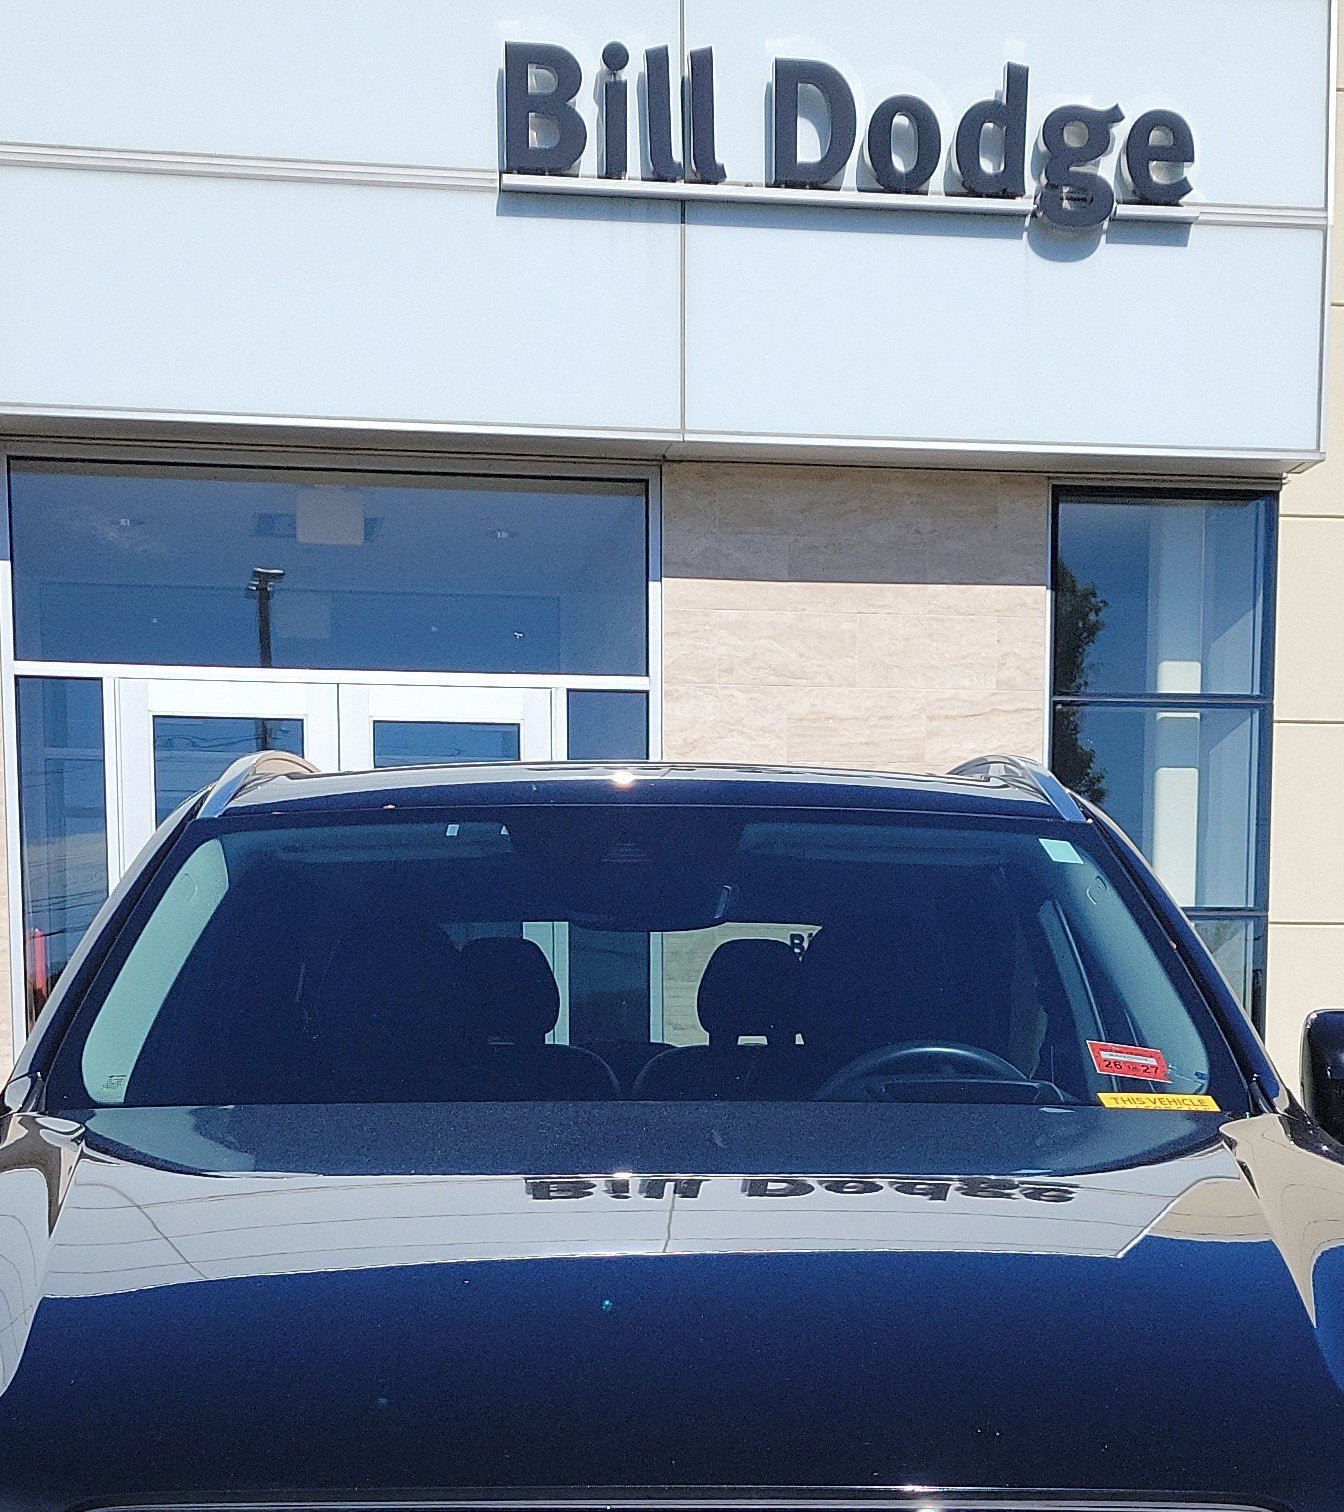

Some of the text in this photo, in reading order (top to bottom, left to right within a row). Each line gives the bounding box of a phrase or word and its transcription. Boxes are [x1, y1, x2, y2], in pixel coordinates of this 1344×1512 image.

[503, 40, 1196, 229] Bill Dodge
[1109, 1096, 1208, 1107] THIS VEHICLE
